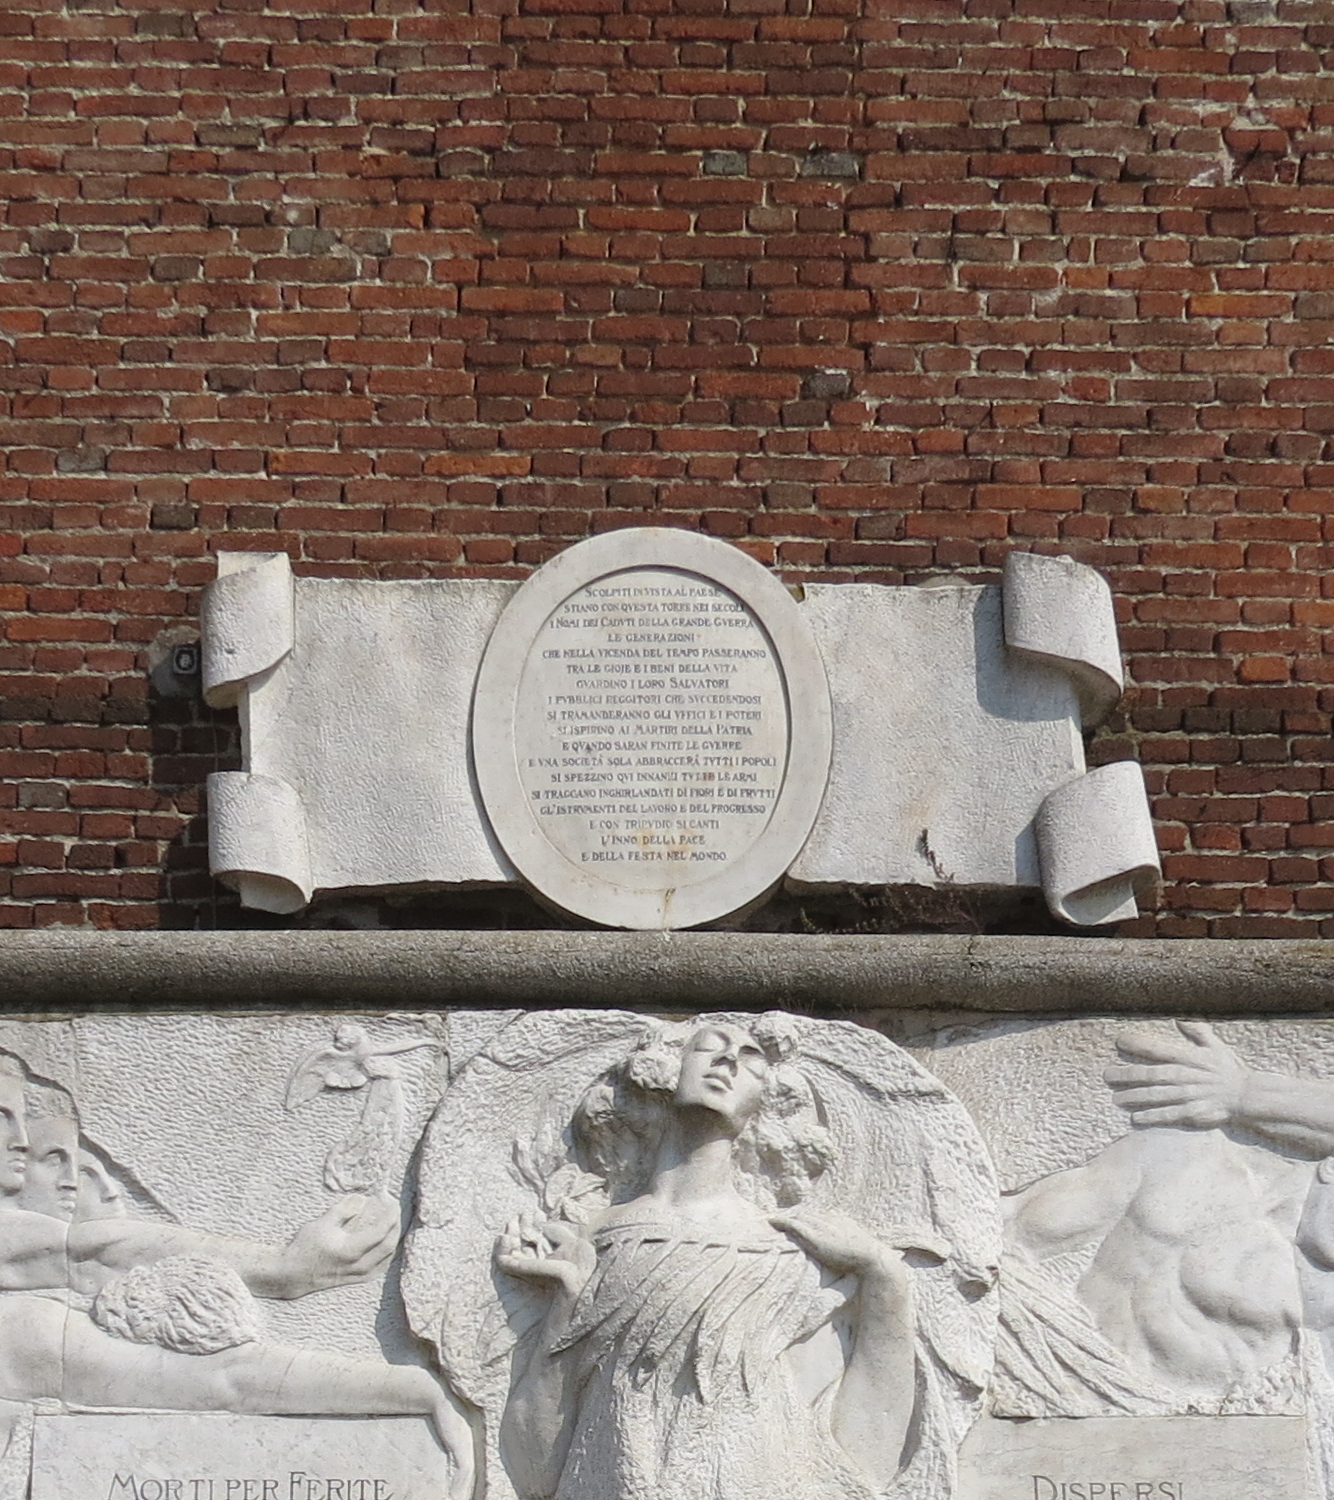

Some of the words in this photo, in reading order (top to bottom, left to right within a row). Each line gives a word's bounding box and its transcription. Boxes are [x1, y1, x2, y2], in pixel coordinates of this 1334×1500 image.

[626, 634, 694, 643] GENERAZIONI
[598, 649, 640, 658] VICENDA
[643, 649, 662, 658] DEL
[666, 649, 698, 658] TEMPO
[651, 664, 674, 673] BENI
[679, 664, 710, 673] DELLA
[638, 680, 665, 689] LORO
